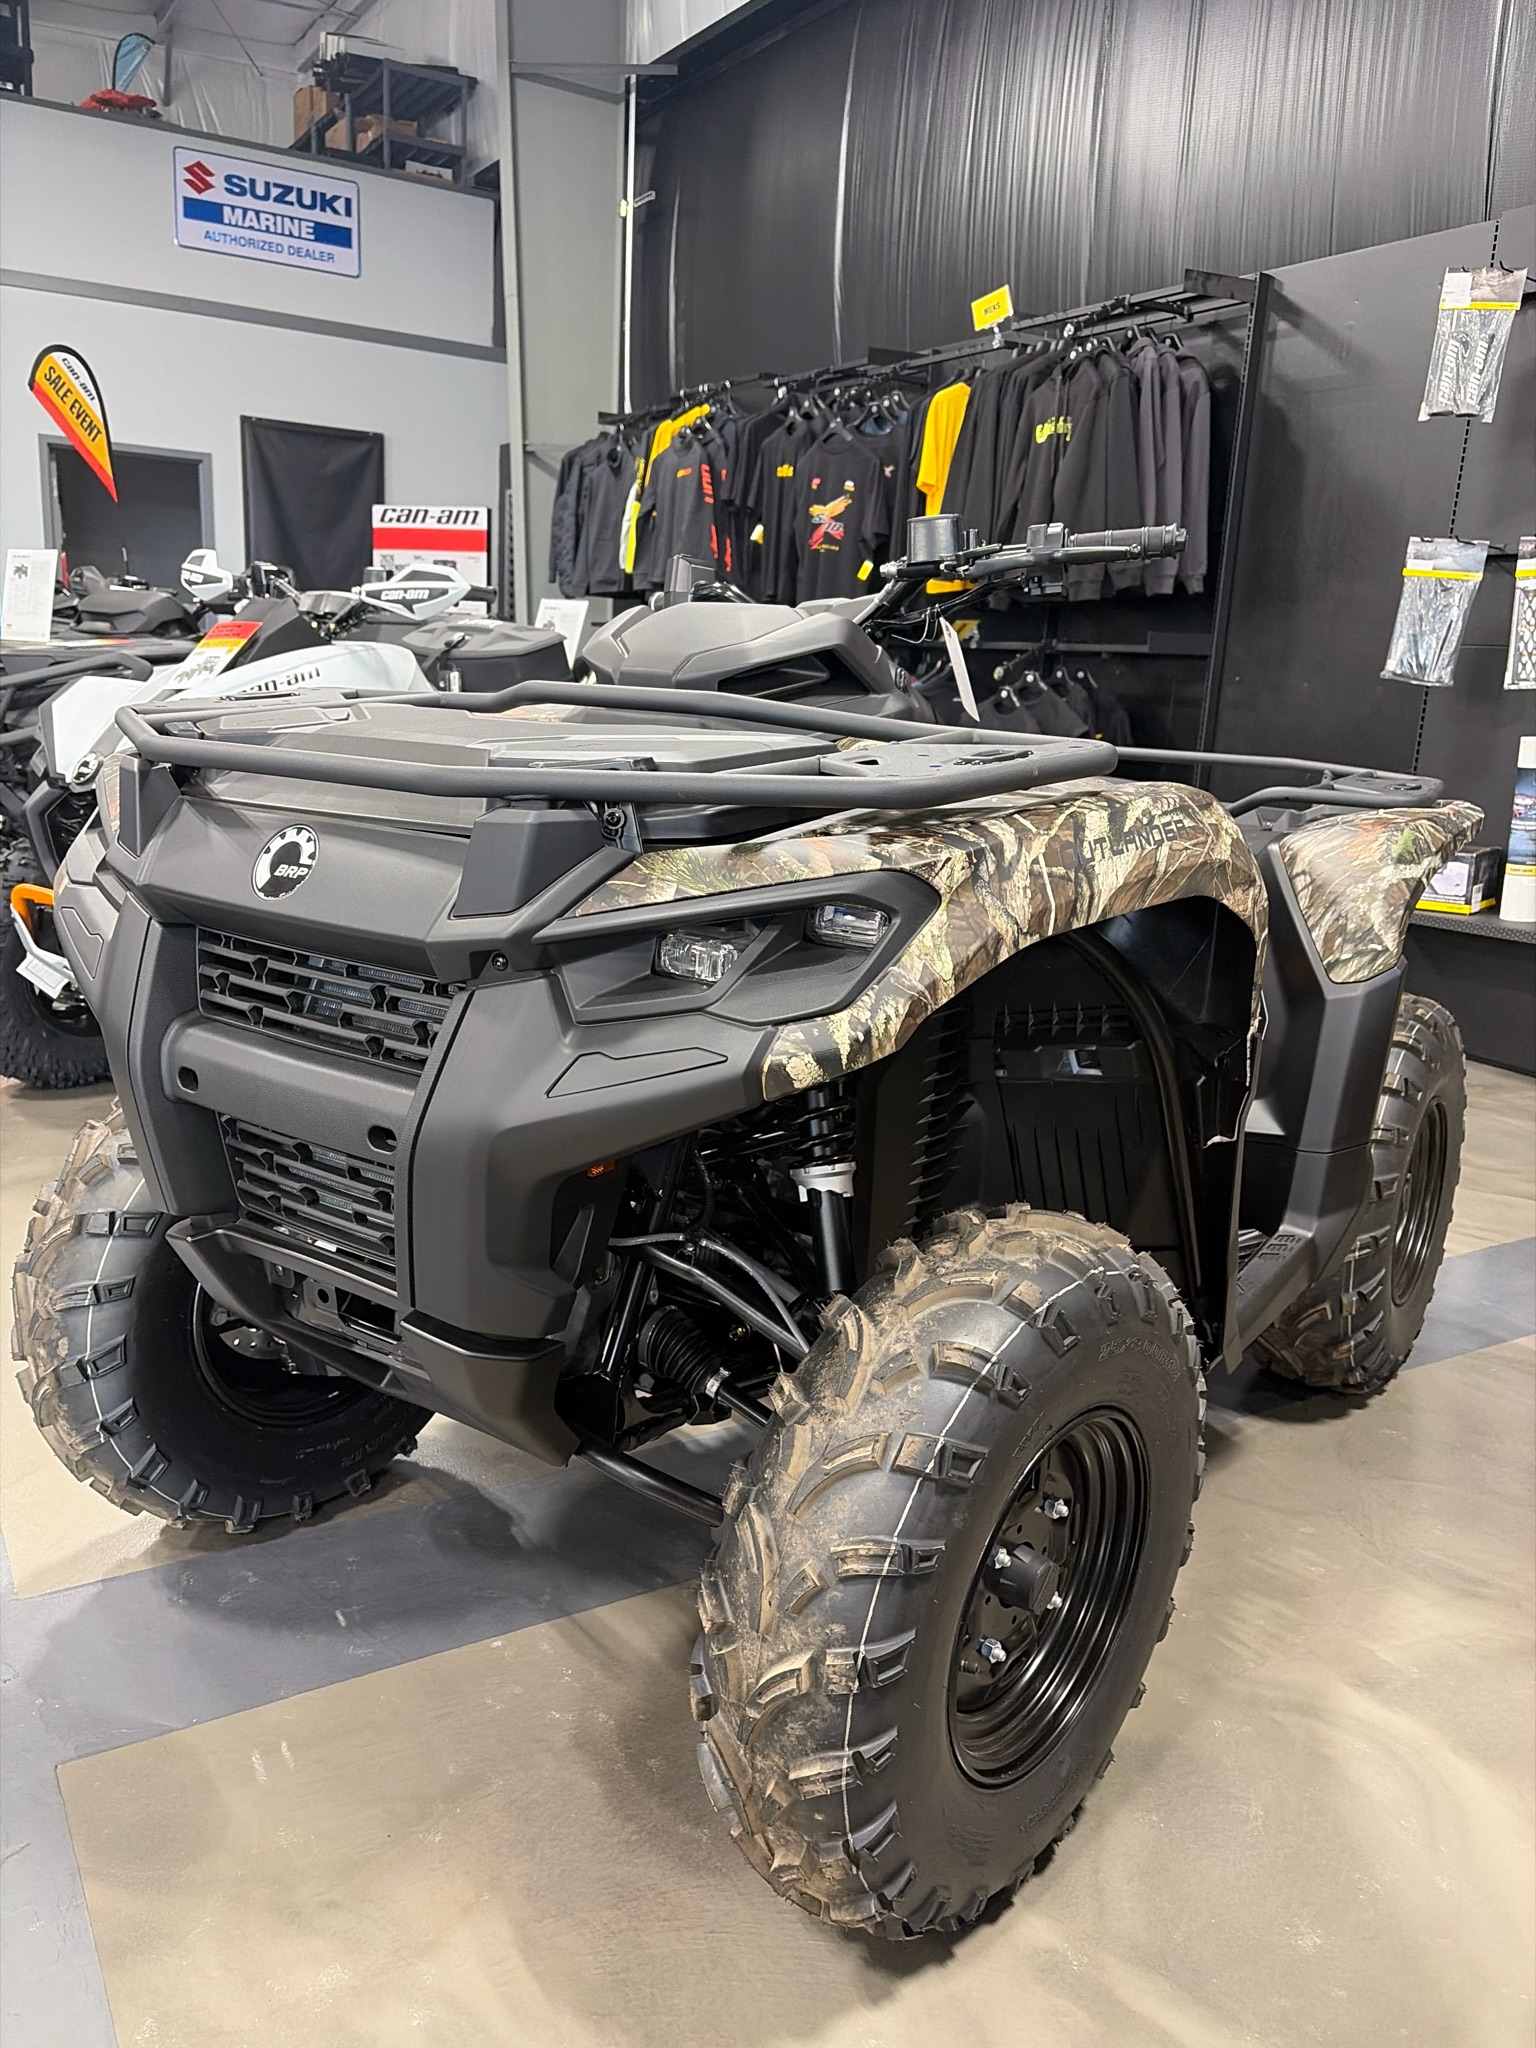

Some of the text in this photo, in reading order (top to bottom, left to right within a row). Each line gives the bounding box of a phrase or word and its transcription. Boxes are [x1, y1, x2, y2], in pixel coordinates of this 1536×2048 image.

[224, 173, 352, 218] SUZUKI
[222, 205, 315, 240] MARINE
[203, 230, 335, 264] AUTHORIZED DEALER
[61, 357, 96, 401] can-am
[1439, 339, 1460, 405] can-am
[1466, 339, 1489, 405] can-am
[43, 365, 103, 443] SALE EVENT
[379, 508, 480, 525] can-am
[380, 588, 430, 602] can-am
[239, 665, 322, 693] an-am
[1060, 818, 1190, 871] OUTLANDER
[274, 863, 309, 879] BRP
